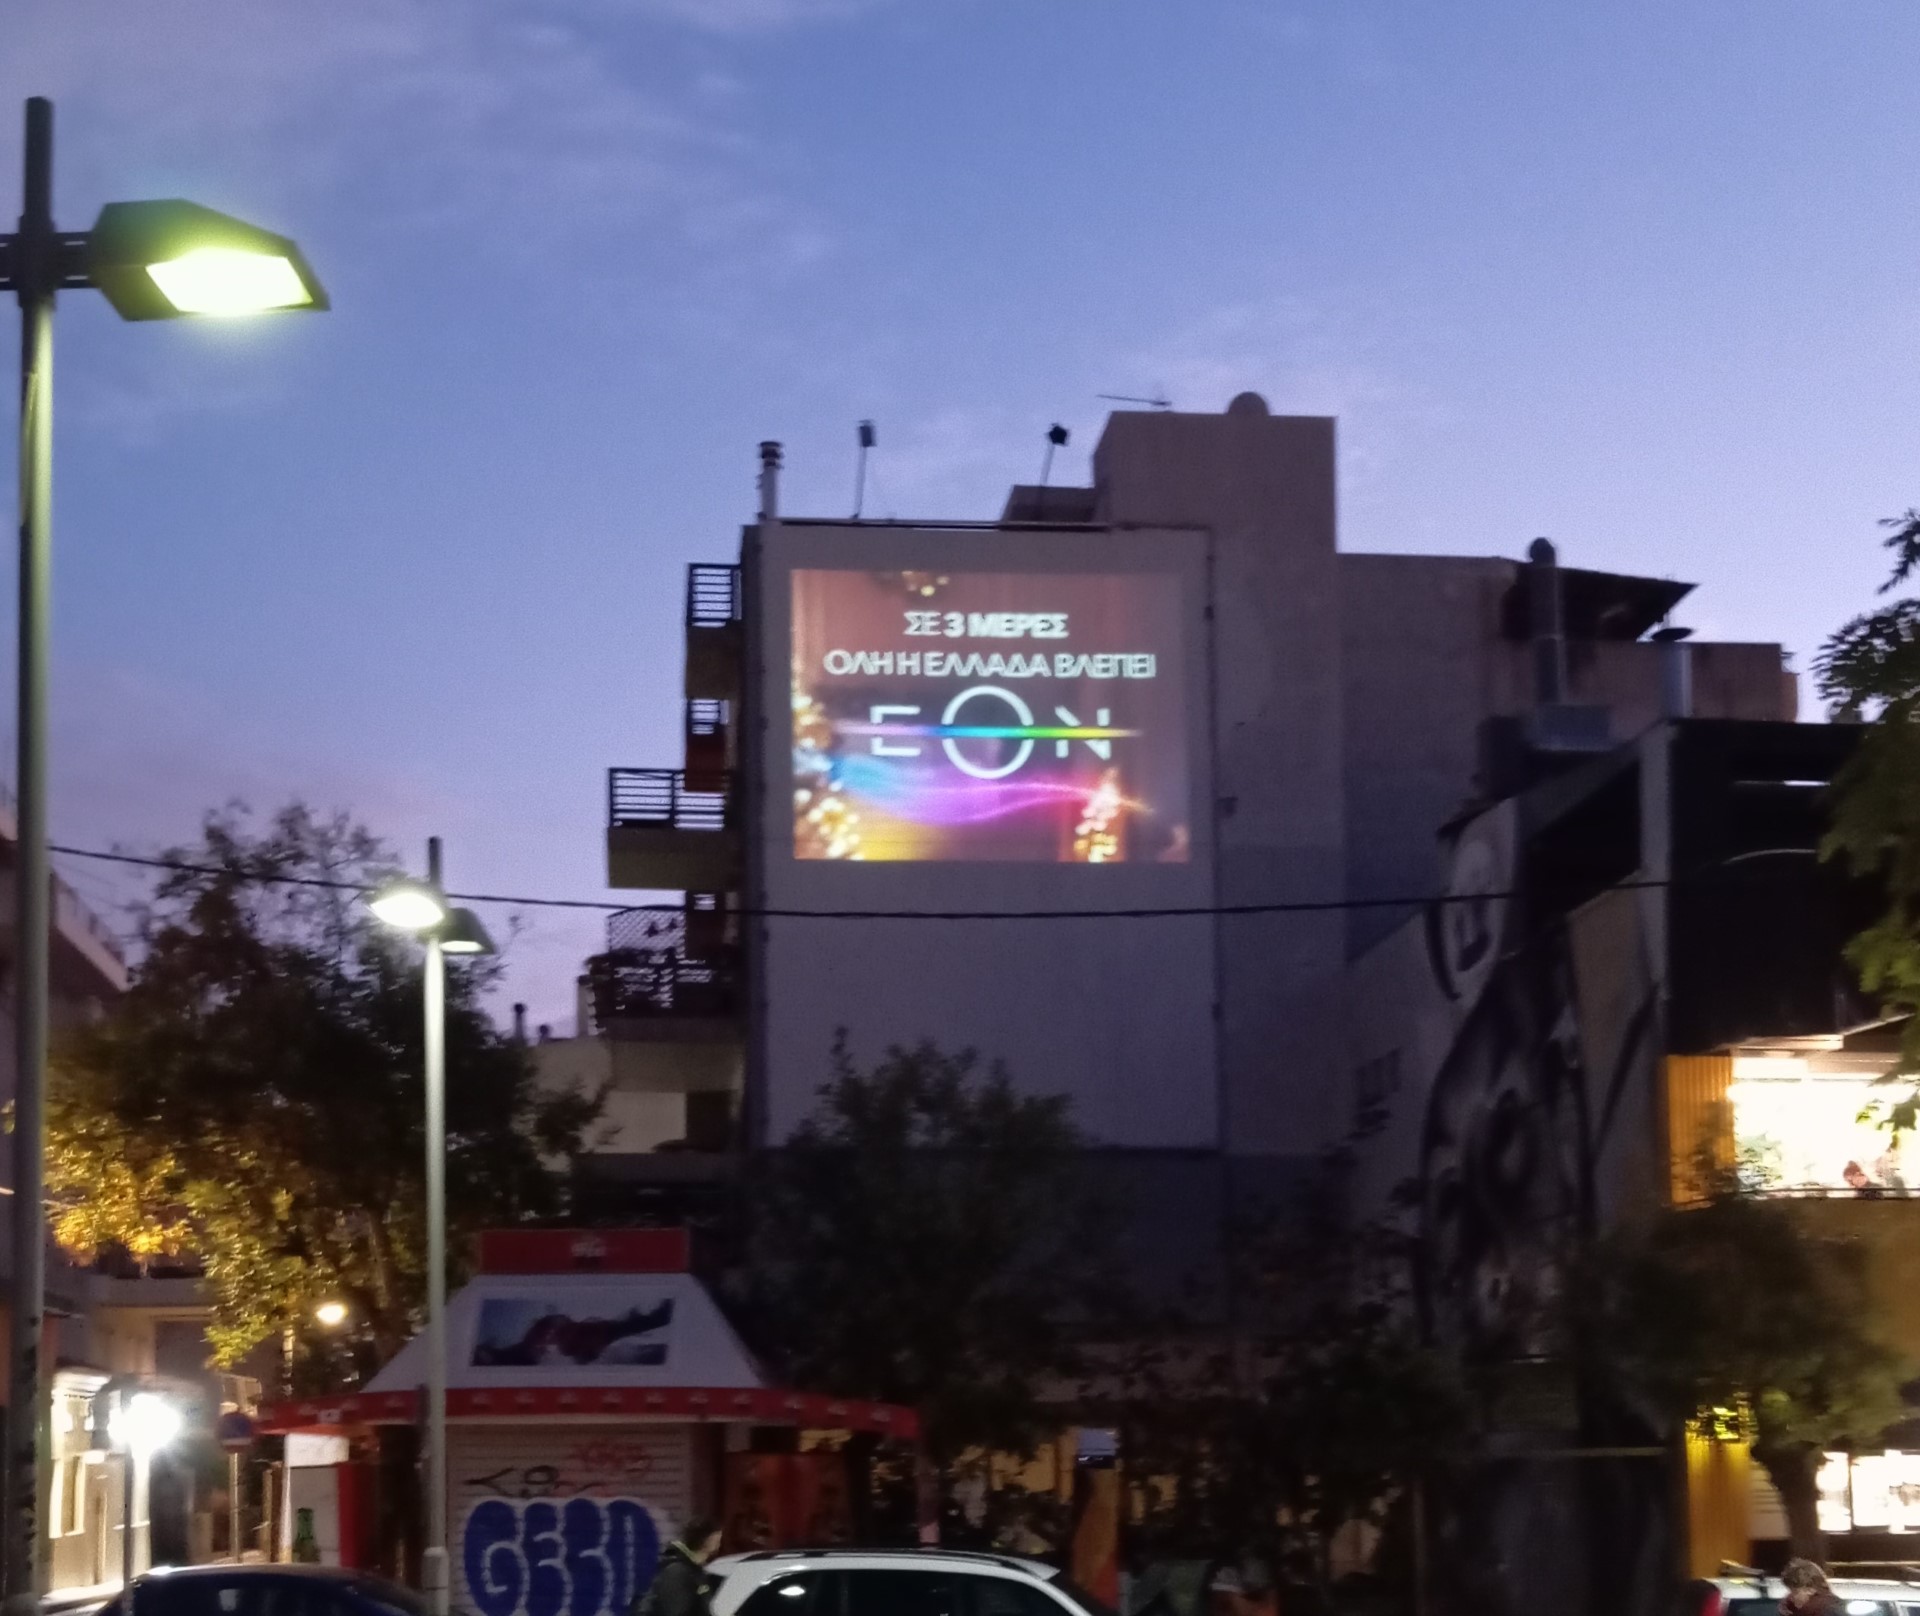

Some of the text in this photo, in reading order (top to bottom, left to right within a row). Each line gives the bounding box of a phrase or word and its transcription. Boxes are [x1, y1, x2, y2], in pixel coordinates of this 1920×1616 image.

[903, 611, 1069, 638] ΣΕ 3 ΜΕΡΕΣ
[823, 649, 893, 675] ΟΛΗ
[896, 651, 921, 675] Η
[923, 651, 1052, 677] ΕΛΛΑΔΑ
[869, 684, 1112, 779] EON
